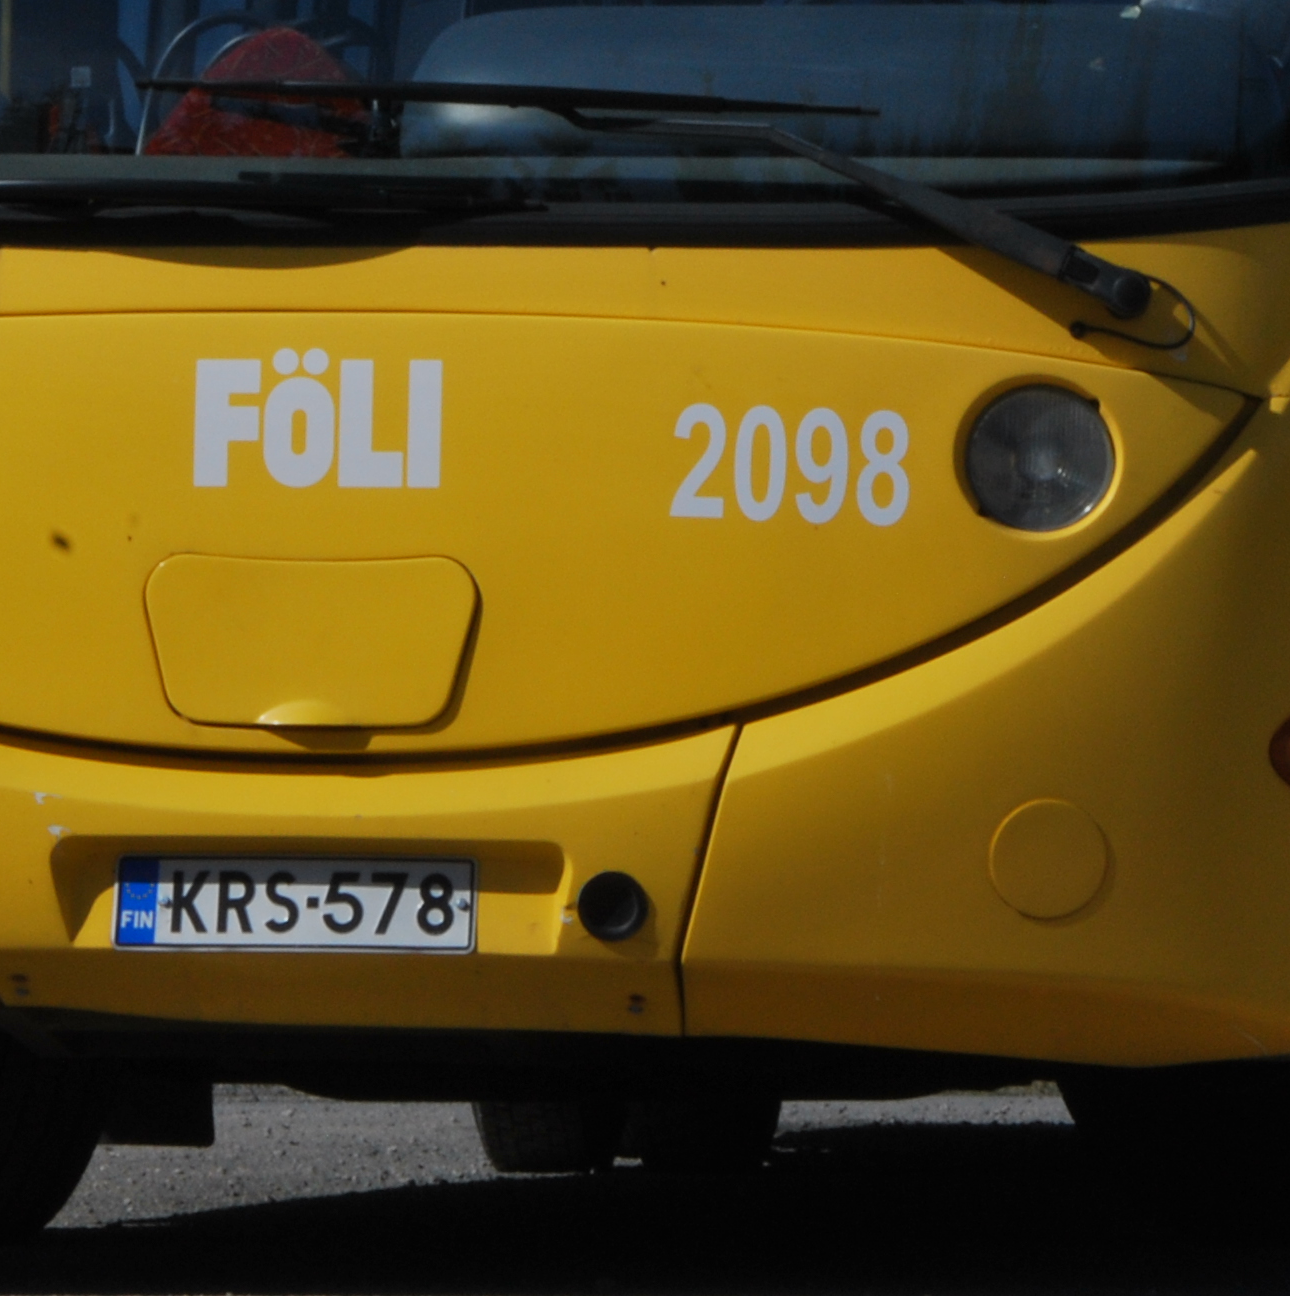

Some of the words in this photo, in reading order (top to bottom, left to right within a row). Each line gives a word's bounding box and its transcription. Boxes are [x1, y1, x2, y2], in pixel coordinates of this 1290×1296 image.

[193, 347, 443, 489] FÖLI
[669, 403, 910, 527] 2098
[120, 909, 154, 929] FIN
[169, 870, 455, 936] KRS-578
